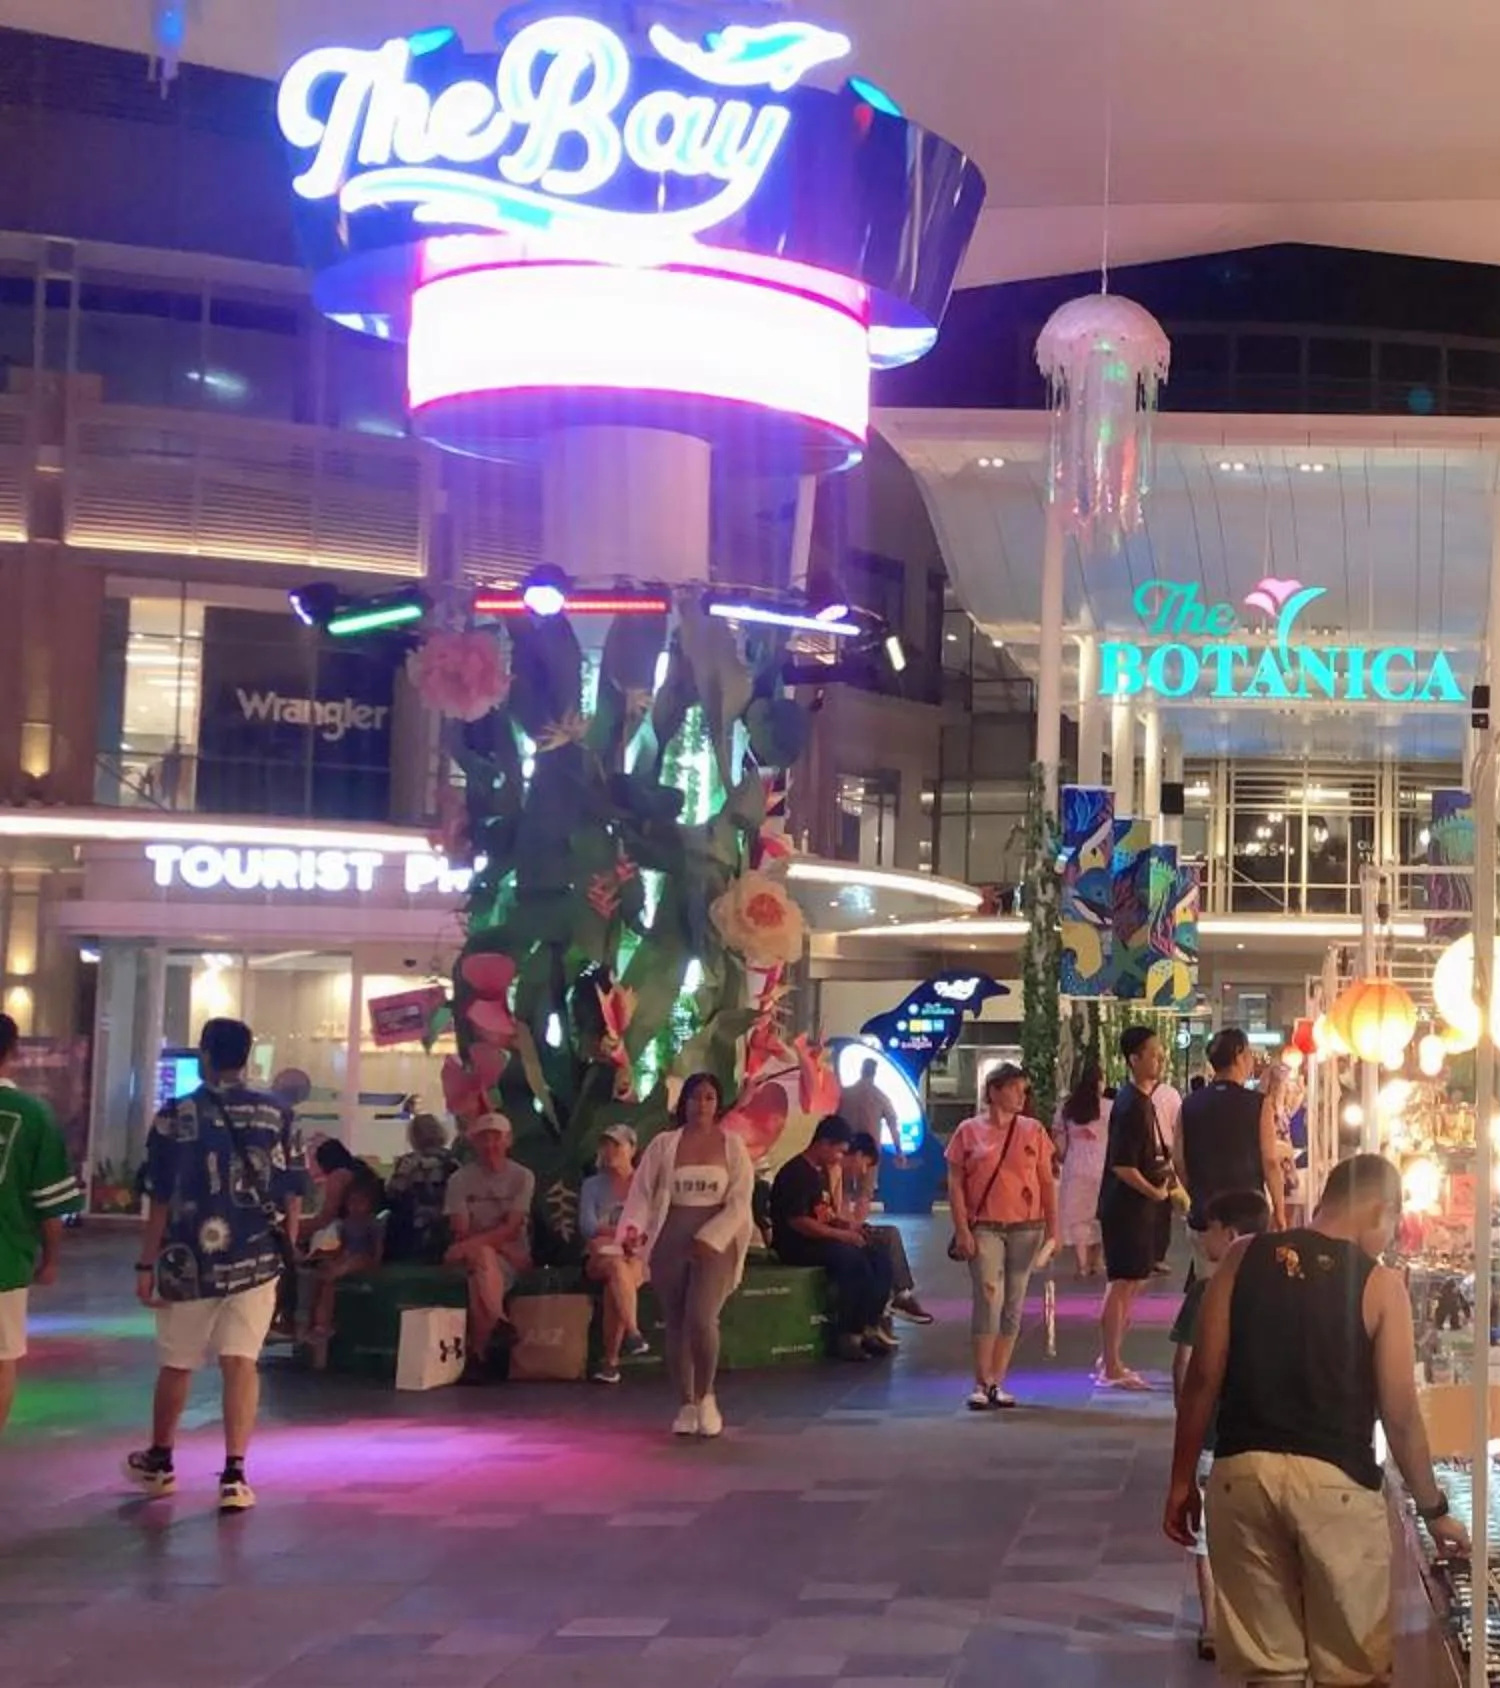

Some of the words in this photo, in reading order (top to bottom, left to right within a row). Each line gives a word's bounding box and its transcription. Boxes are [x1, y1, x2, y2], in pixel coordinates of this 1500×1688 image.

[277, 36, 512, 200] The
[495, 14, 793, 230] Bay
[1133, 578, 1238, 637] The
[1098, 641, 1466, 702] BOTANICA
[236, 688, 388, 741] Wrangler
[145, 844, 384, 892] TOURIST
